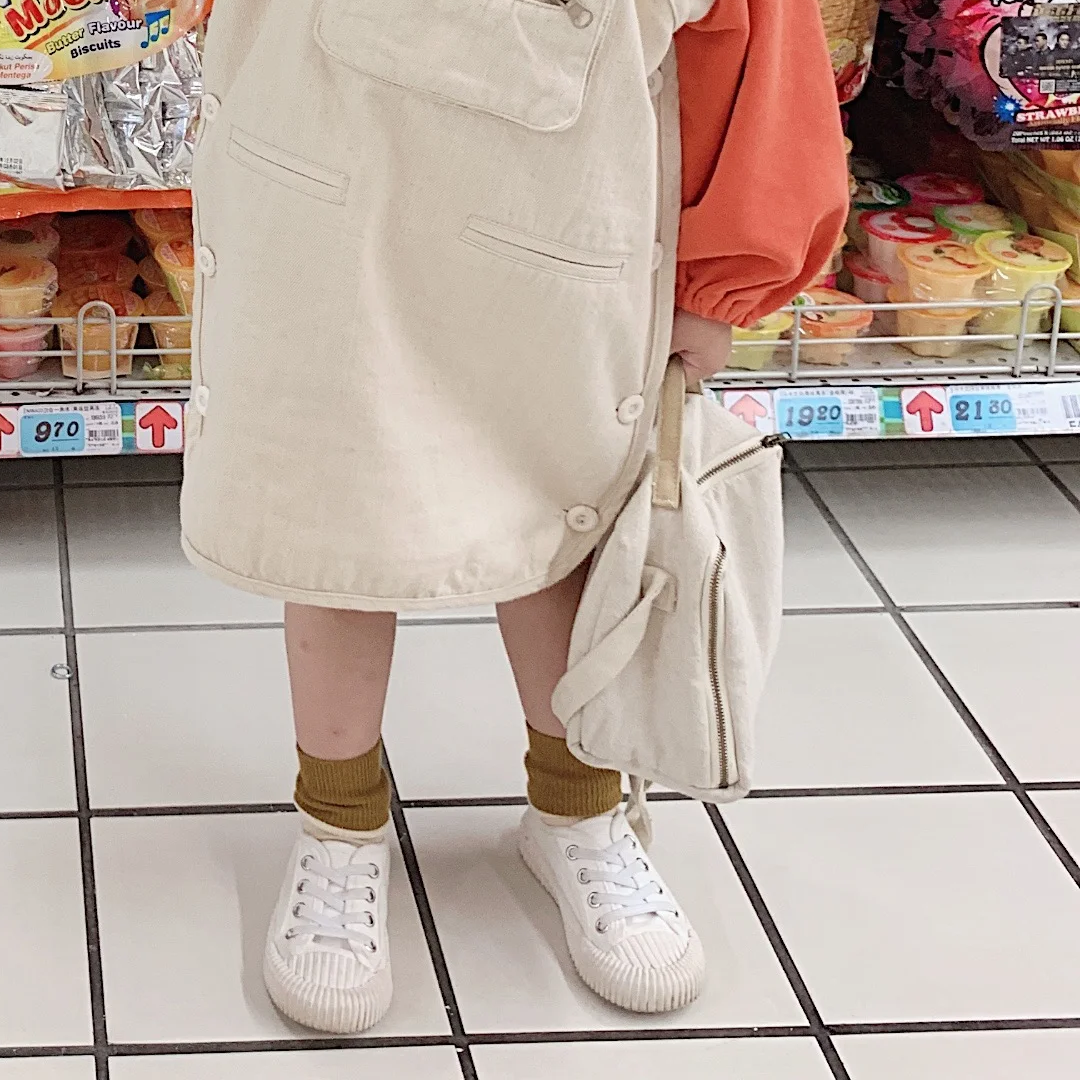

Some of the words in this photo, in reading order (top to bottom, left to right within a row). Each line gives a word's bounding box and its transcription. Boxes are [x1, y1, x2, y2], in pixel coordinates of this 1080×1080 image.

[45, 28, 84, 55] Butter
[88, 19, 143, 35] Flavour
[70, 39, 121, 59] Biscuits
[785, 405, 841, 427] 1920
[34, 420, 79, 443] 970
